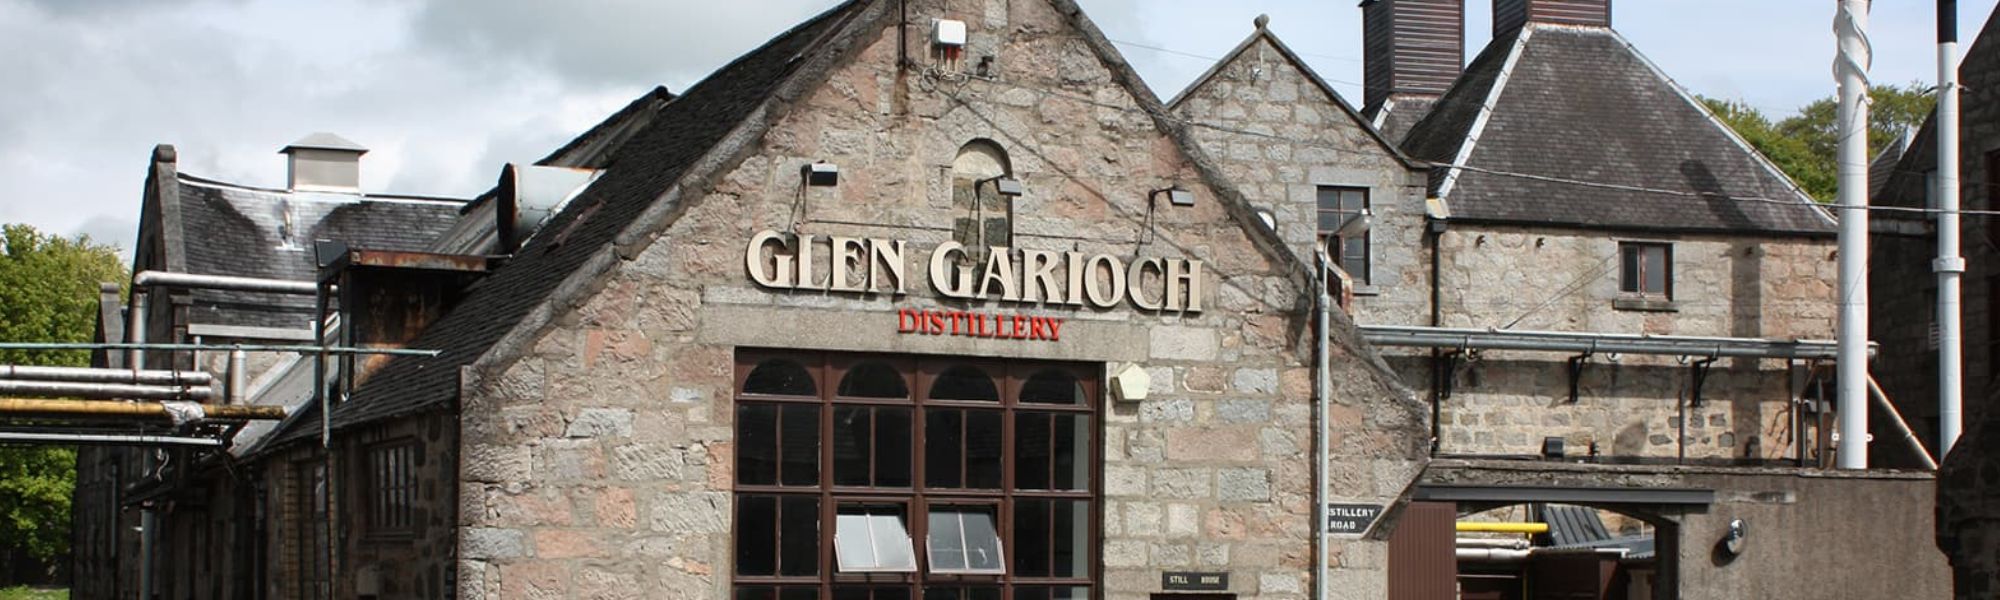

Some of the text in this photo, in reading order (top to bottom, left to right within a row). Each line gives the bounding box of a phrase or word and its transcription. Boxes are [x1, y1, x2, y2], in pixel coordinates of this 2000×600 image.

[746, 230, 1203, 313] GLEN GARIOCH
[898, 308, 1064, 340] DISTILLERY
[1327, 507, 1375, 517] STILLERY
[1330, 520, 1356, 530] ROAD
[1169, 575, 1189, 585] STILL
